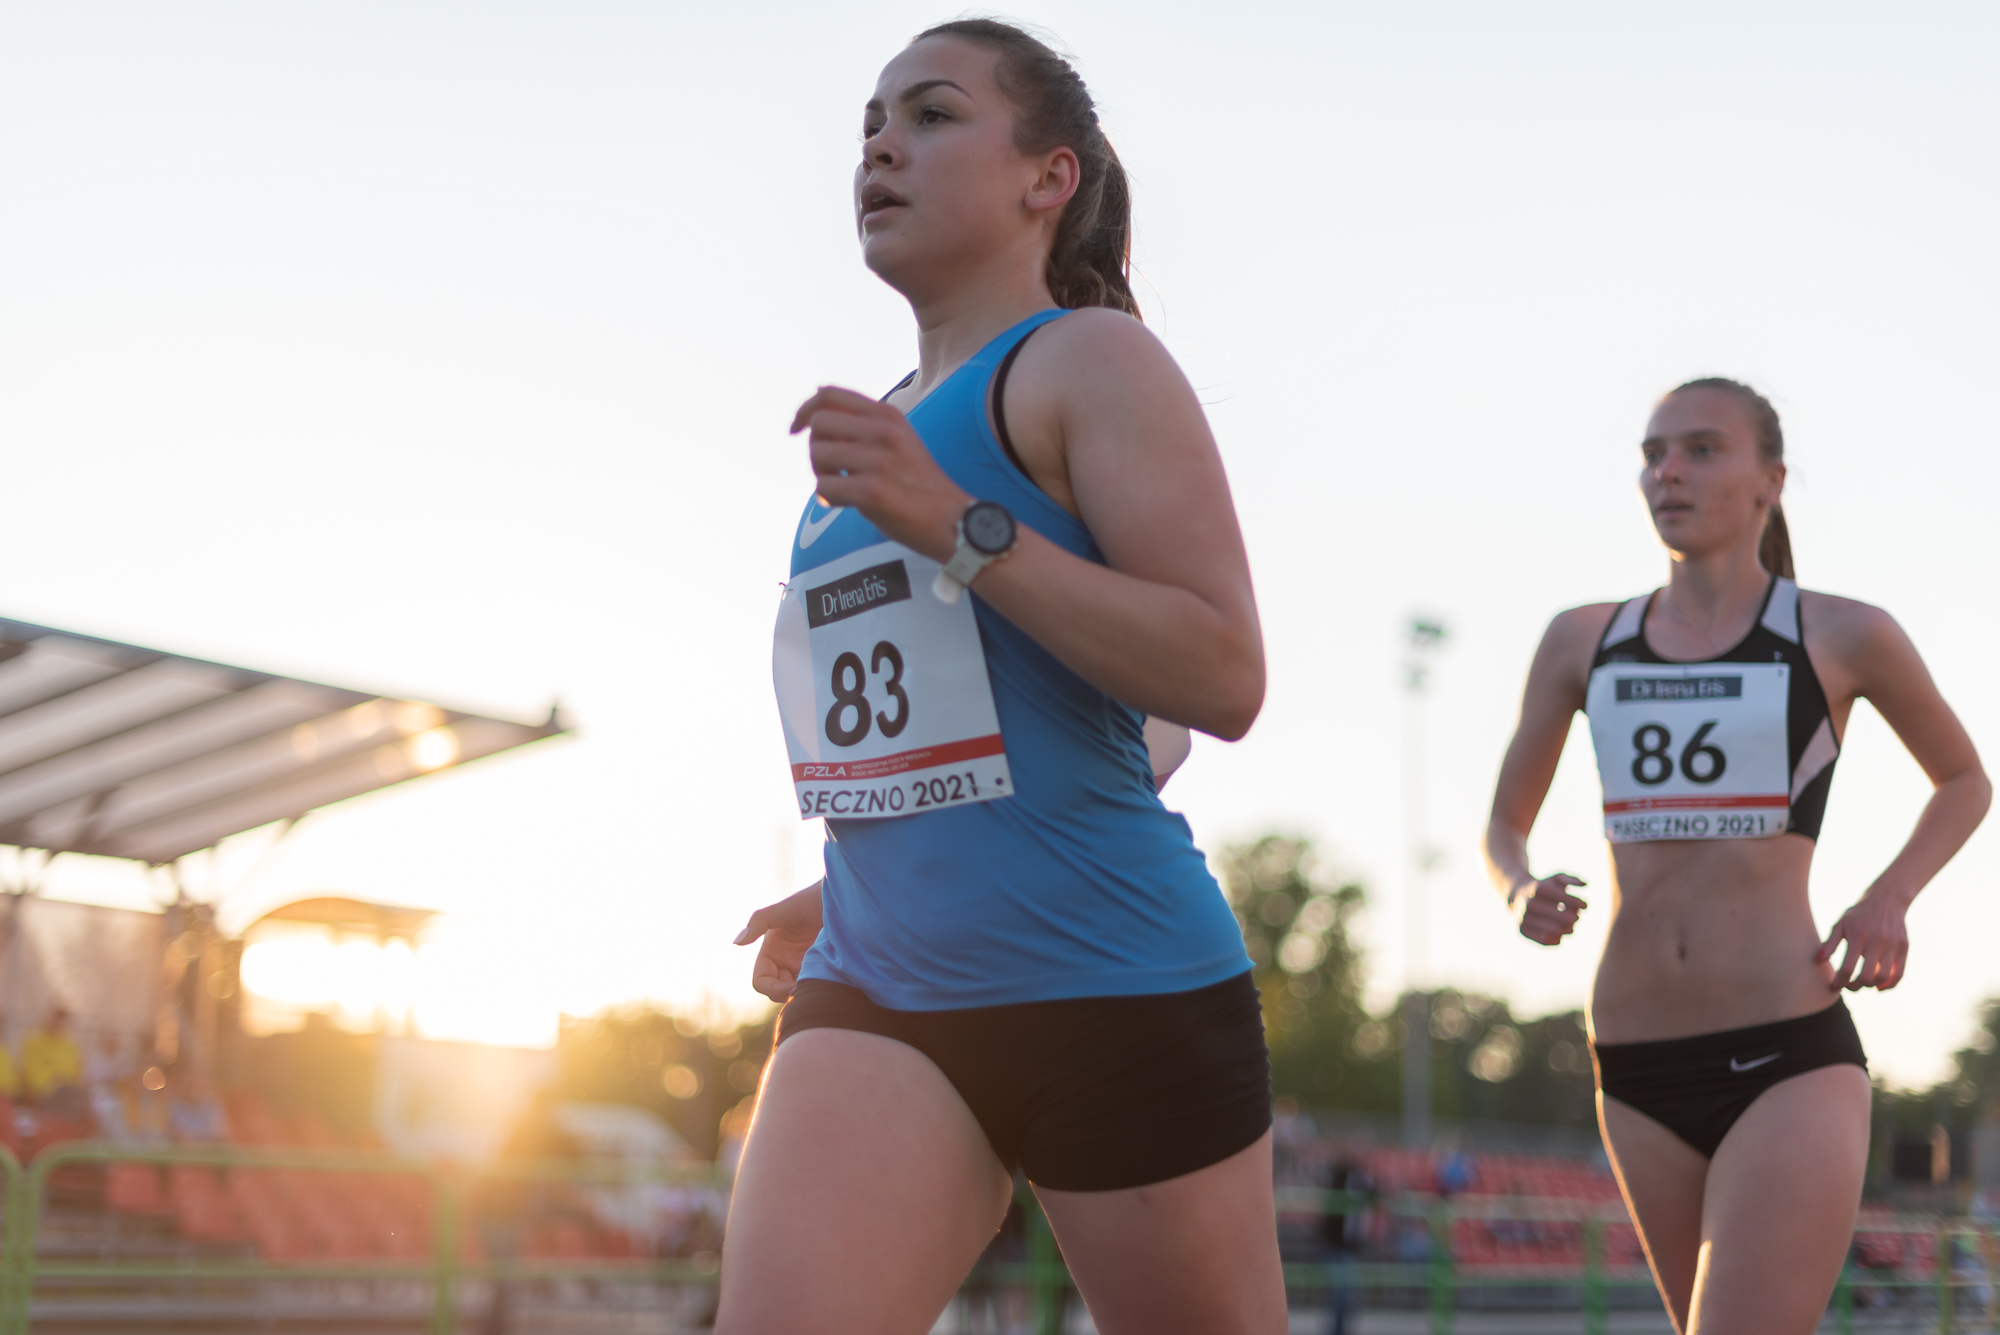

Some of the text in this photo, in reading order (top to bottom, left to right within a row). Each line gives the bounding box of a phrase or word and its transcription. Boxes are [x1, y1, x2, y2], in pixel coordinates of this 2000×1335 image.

[822, 575, 887, 617] Dr Irena Eris
[825, 640, 910, 747] 83
[1631, 677, 1727, 700] Dr Irena Eris
[803, 765, 847, 777] PZLA
[1631, 719, 1727, 785] 86
[801, 772, 979, 814] SECZNO 2021
[1716, 814, 1765, 837] 2021
